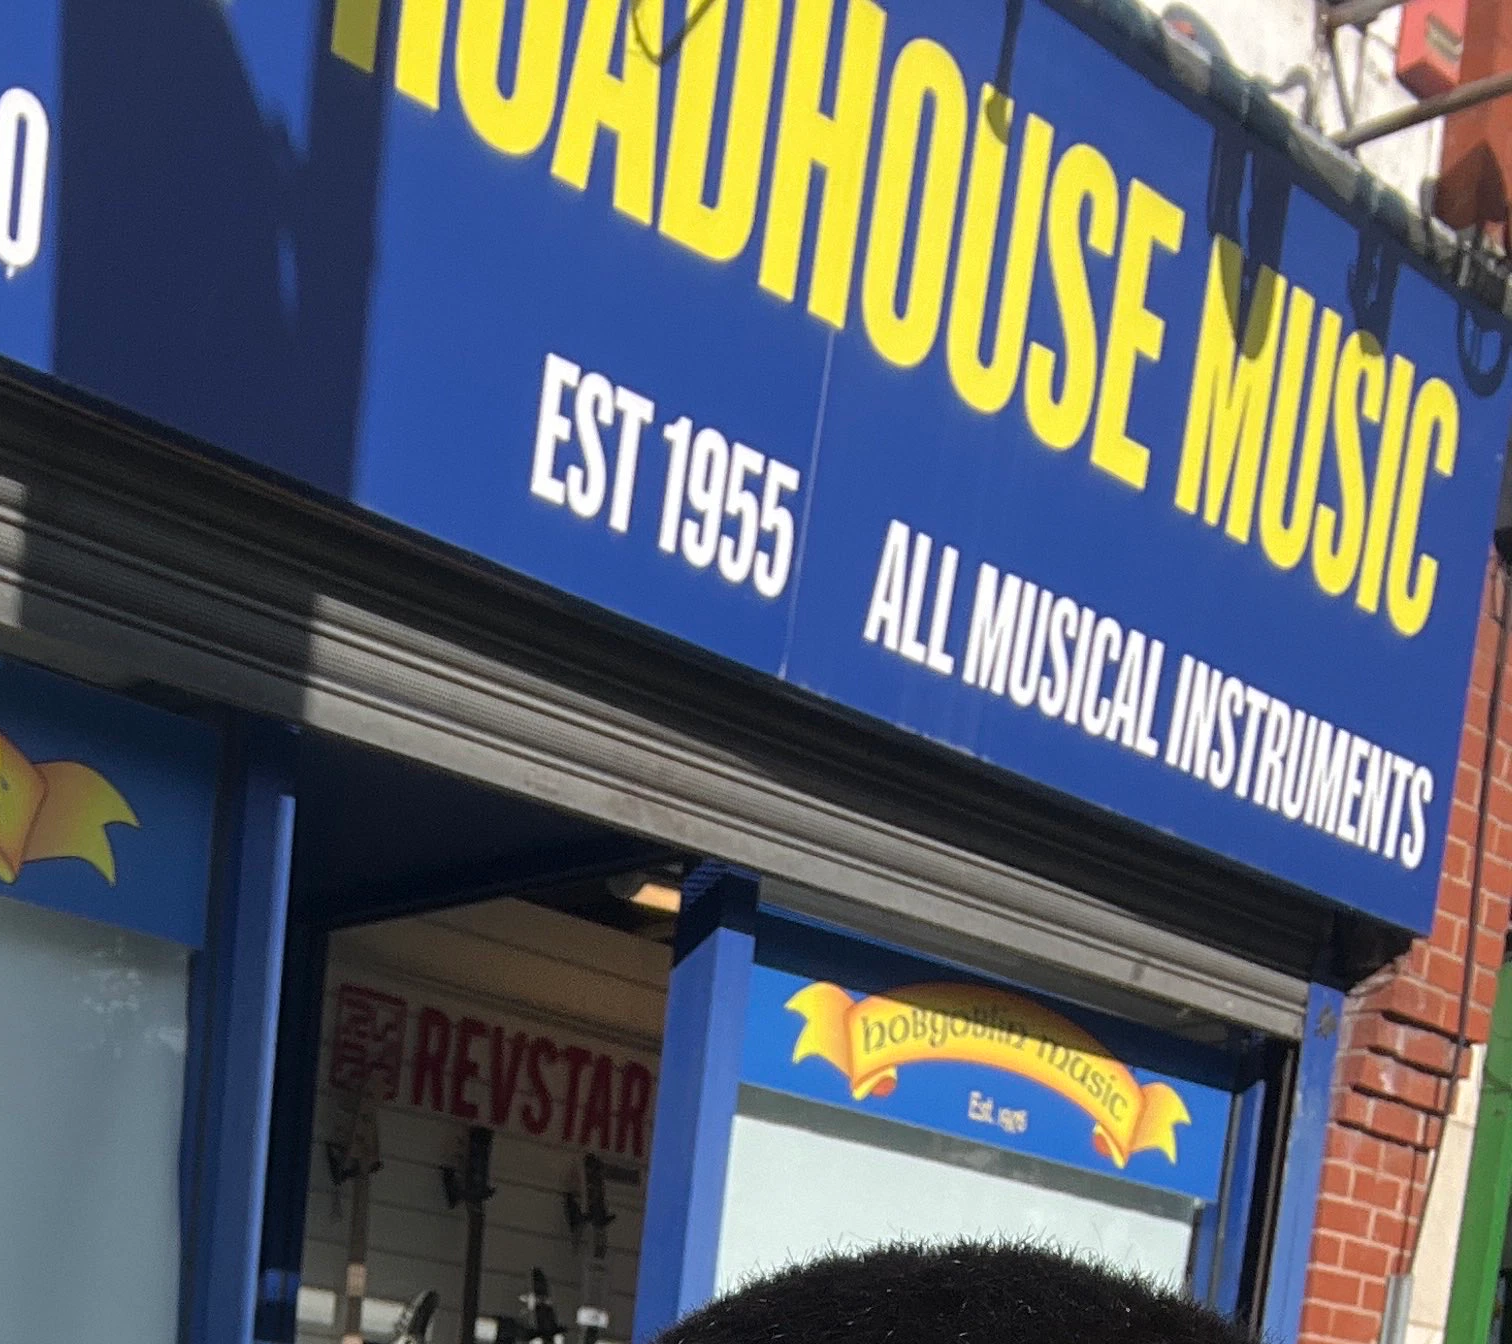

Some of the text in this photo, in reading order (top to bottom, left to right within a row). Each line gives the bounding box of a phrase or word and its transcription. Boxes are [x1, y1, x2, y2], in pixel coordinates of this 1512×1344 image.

[331, 0, 1459, 637] ADHOUSE MUSIC
[529, 352, 801, 598] EST 1955
[863, 519, 1434, 870] ALL MUSICAL INSTRUMENTS
[412, 1006, 654, 1157] REVSTAR
